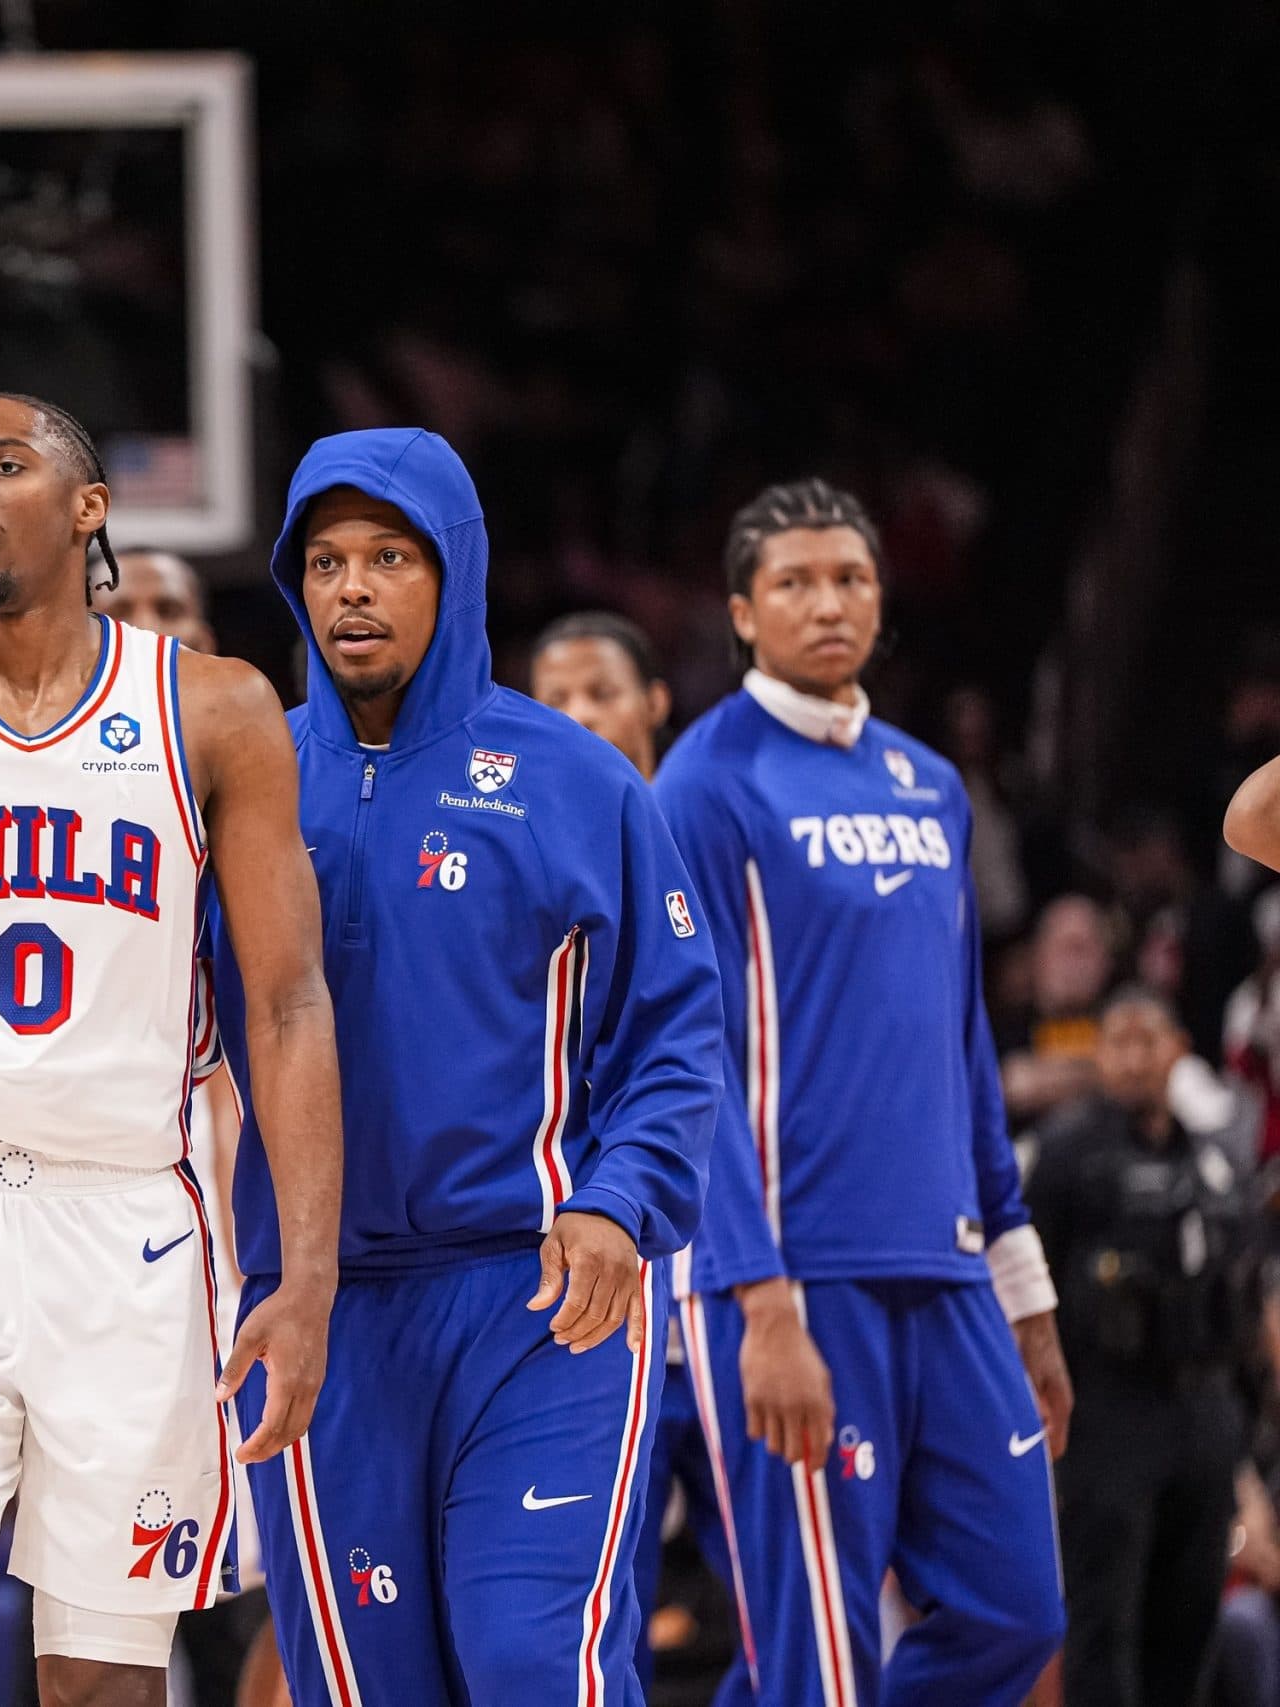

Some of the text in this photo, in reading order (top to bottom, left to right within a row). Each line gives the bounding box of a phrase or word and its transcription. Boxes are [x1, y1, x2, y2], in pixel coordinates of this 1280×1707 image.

[81, 760, 160, 774] crypto.com
[439, 792, 525, 817] Penn Medicine
[789, 813, 952, 871] 76ERS
[417, 849, 468, 891] 76
[127, 1518, 200, 1580] 76
[349, 1564, 399, 1608] 76
